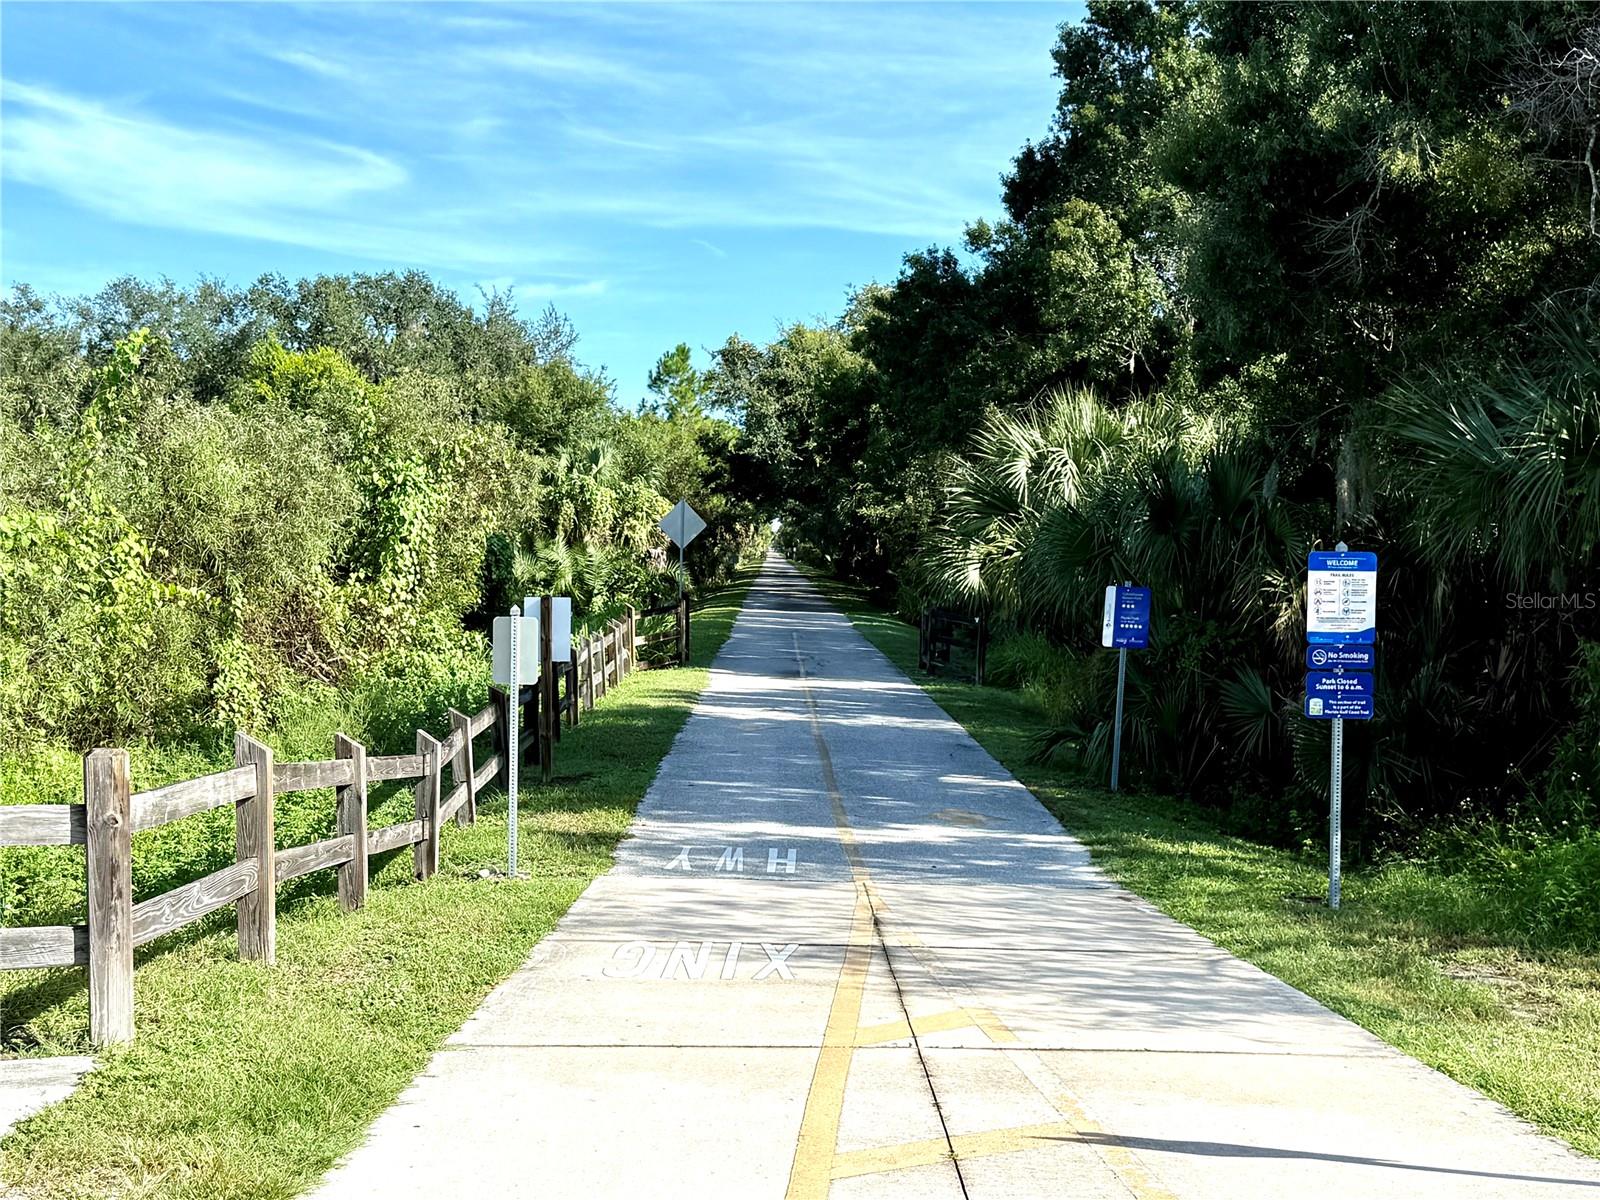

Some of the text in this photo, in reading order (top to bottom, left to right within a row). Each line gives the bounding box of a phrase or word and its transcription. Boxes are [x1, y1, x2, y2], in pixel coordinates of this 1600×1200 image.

[1338, 651, 1369, 660] Smoking
[664, 846, 797, 874] HWY
[601, 940, 801, 980] XING
